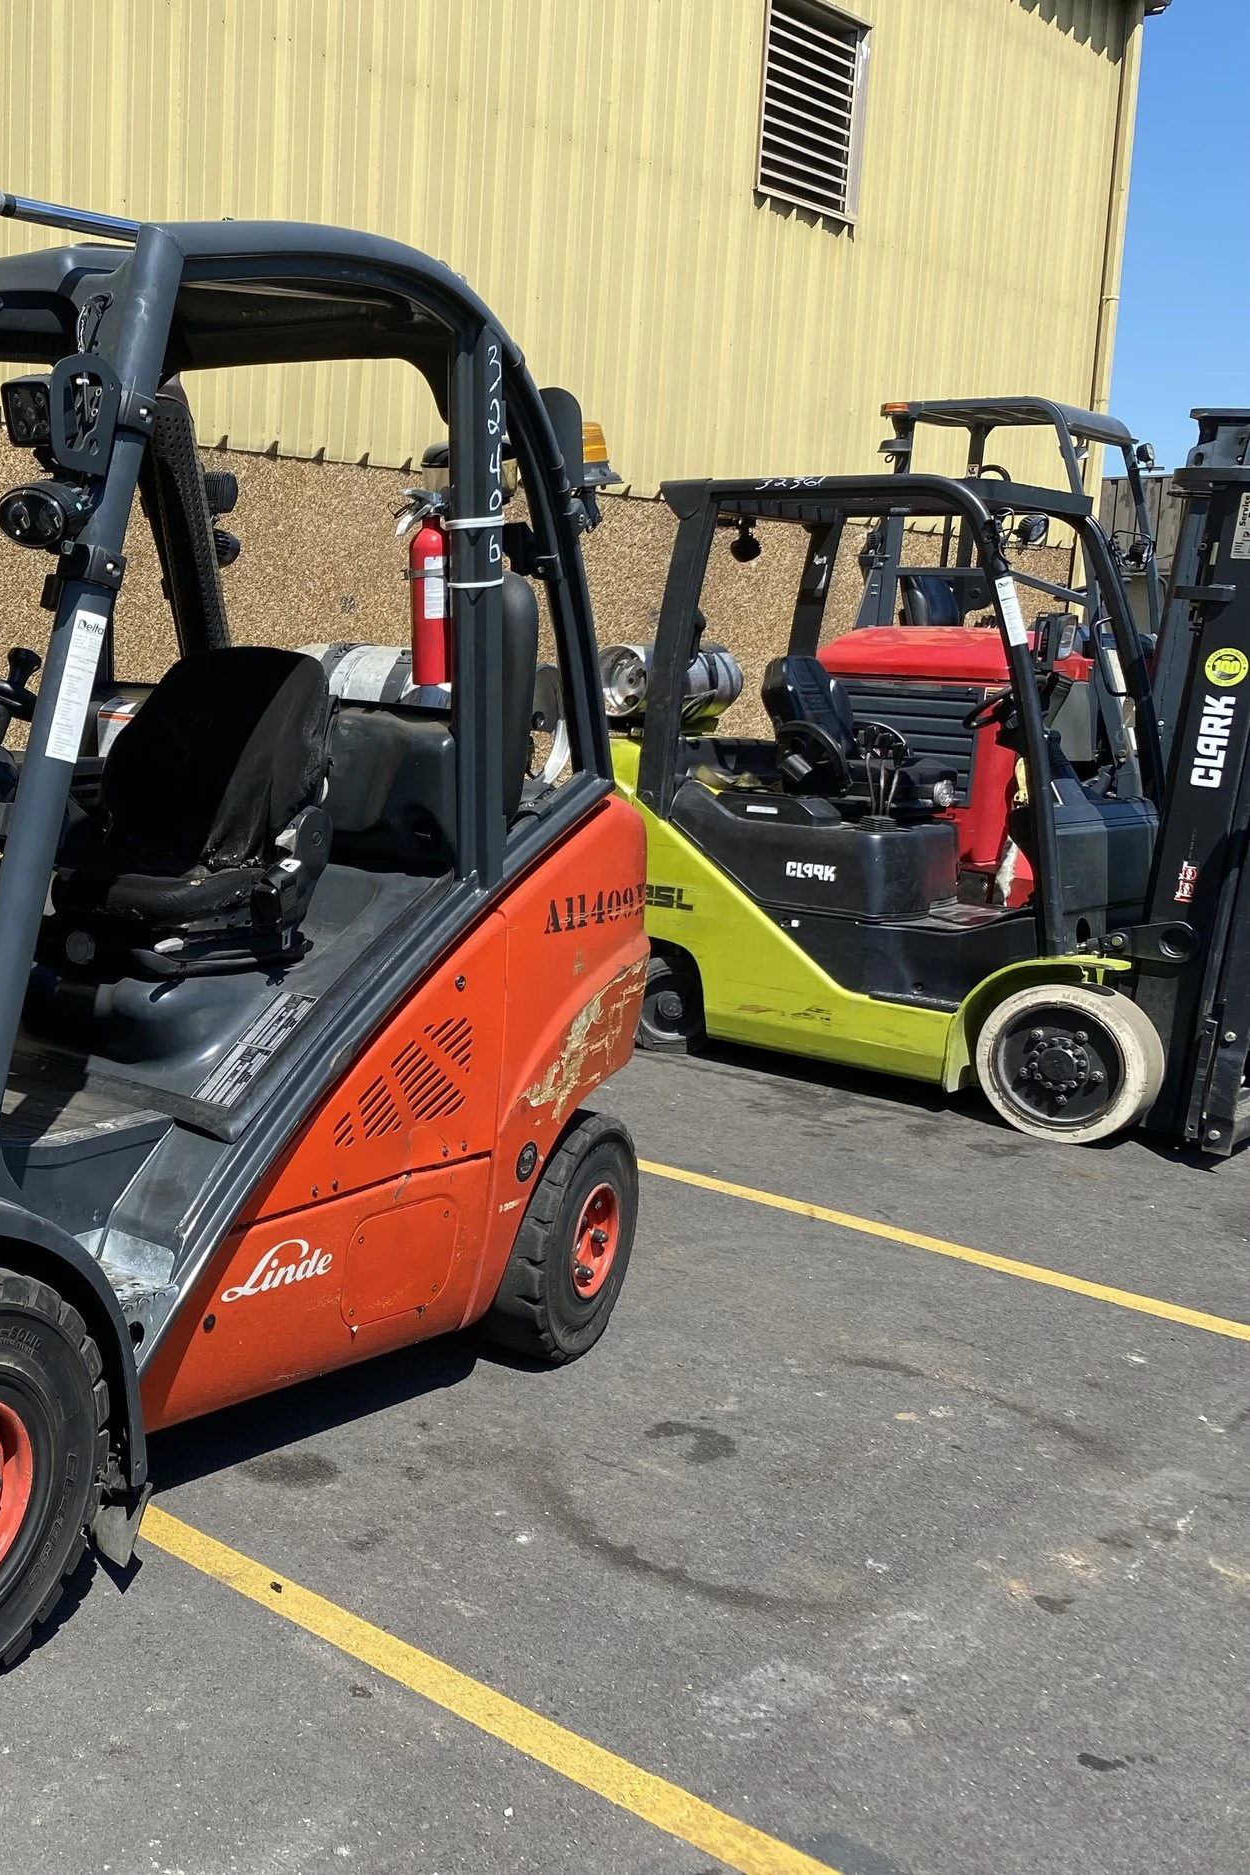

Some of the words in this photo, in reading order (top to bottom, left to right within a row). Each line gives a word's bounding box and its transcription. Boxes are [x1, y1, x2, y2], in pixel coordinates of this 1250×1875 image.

[488, 345, 502, 563] 32406
[78, 619, 105, 635] Delta
[1190, 694, 1236, 788] CLARK
[786, 861, 837, 882] CLARK
[221, 1239, 332, 1302] Linde
